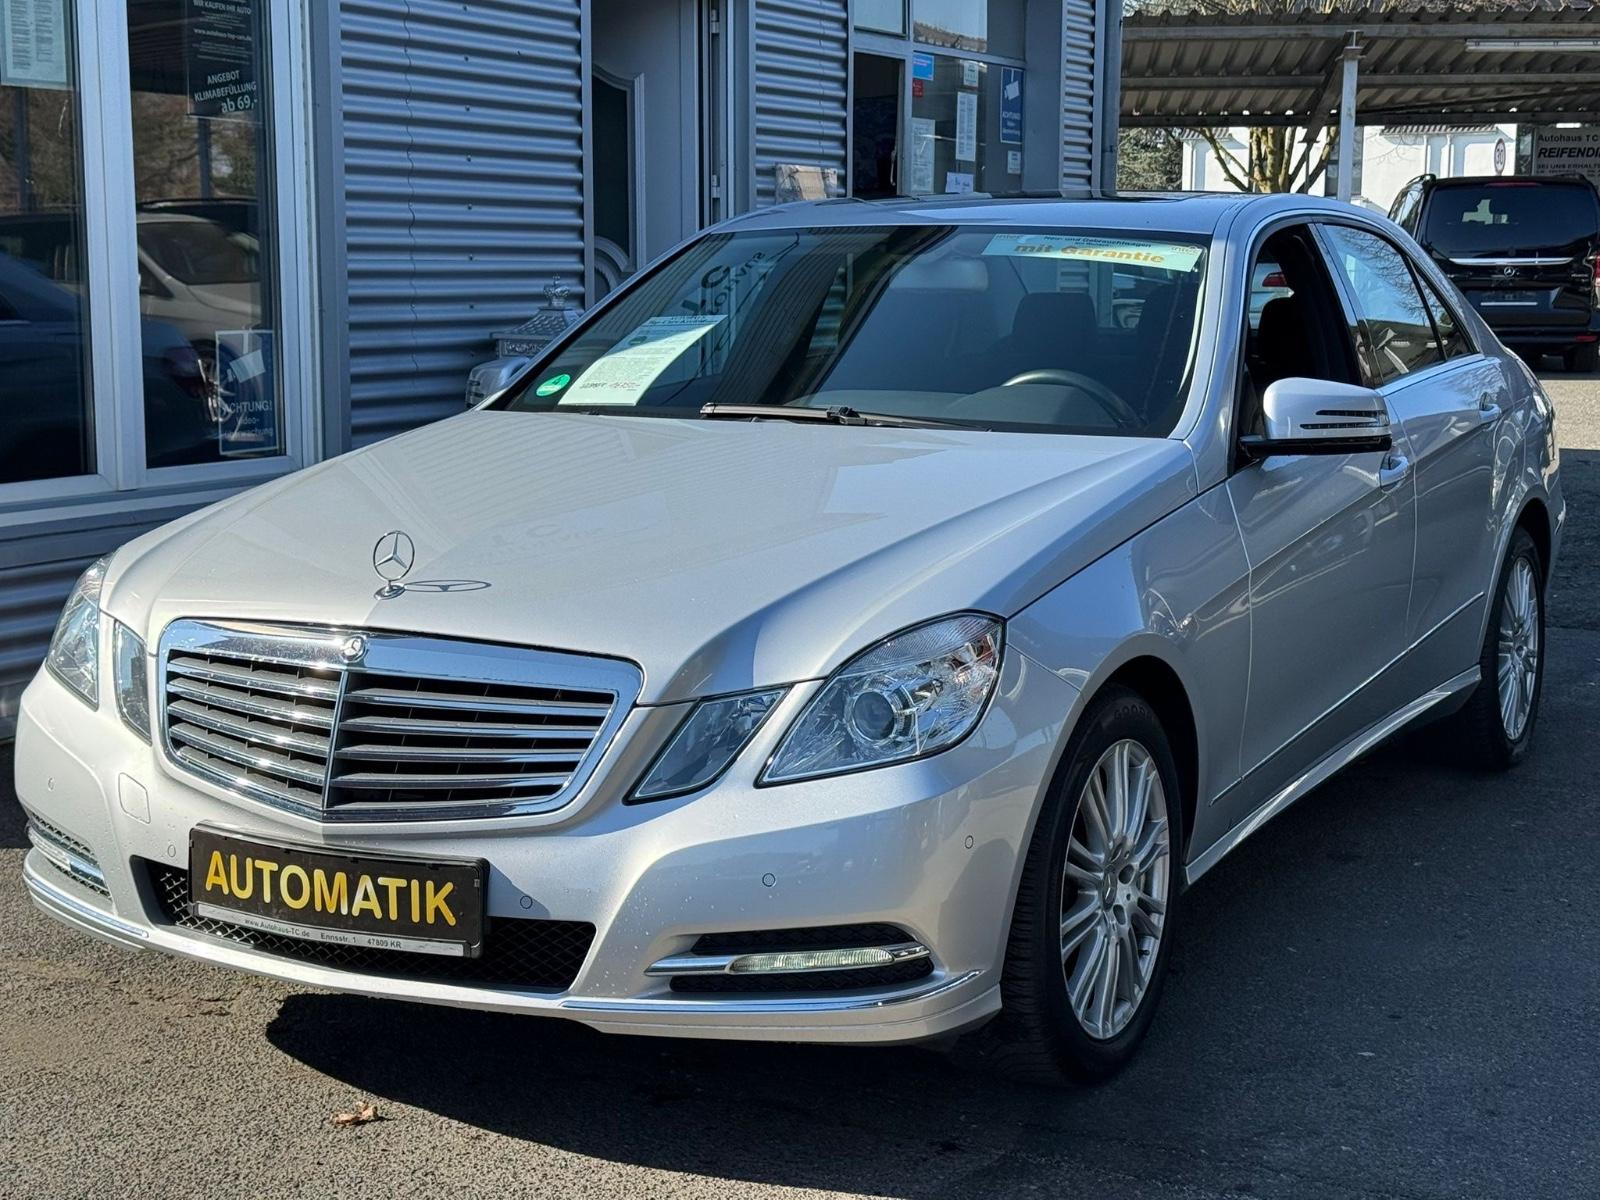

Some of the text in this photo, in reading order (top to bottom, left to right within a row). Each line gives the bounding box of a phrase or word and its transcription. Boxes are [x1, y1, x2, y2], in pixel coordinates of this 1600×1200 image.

[207, 69, 240, 85] ANGEBOT
[194, 81, 257, 102] KLIMABEFÜLLUNG
[221, 94, 258, 114] ab 69,-
[1538, 134, 1582, 143] Autohaus
[1537, 146, 1600, 159] REIFENDI
[1013, 243, 1055, 254] mit
[1060, 245, 1166, 263] Garantie
[205, 850, 457, 927] AUTOMATIK
[244, 918, 311, 938] www.Autohaus-TC.de
[320, 932, 350, 943] Ennsstr.
[367, 938, 389, 947] 47809
[390, 940, 402, 949] KR
